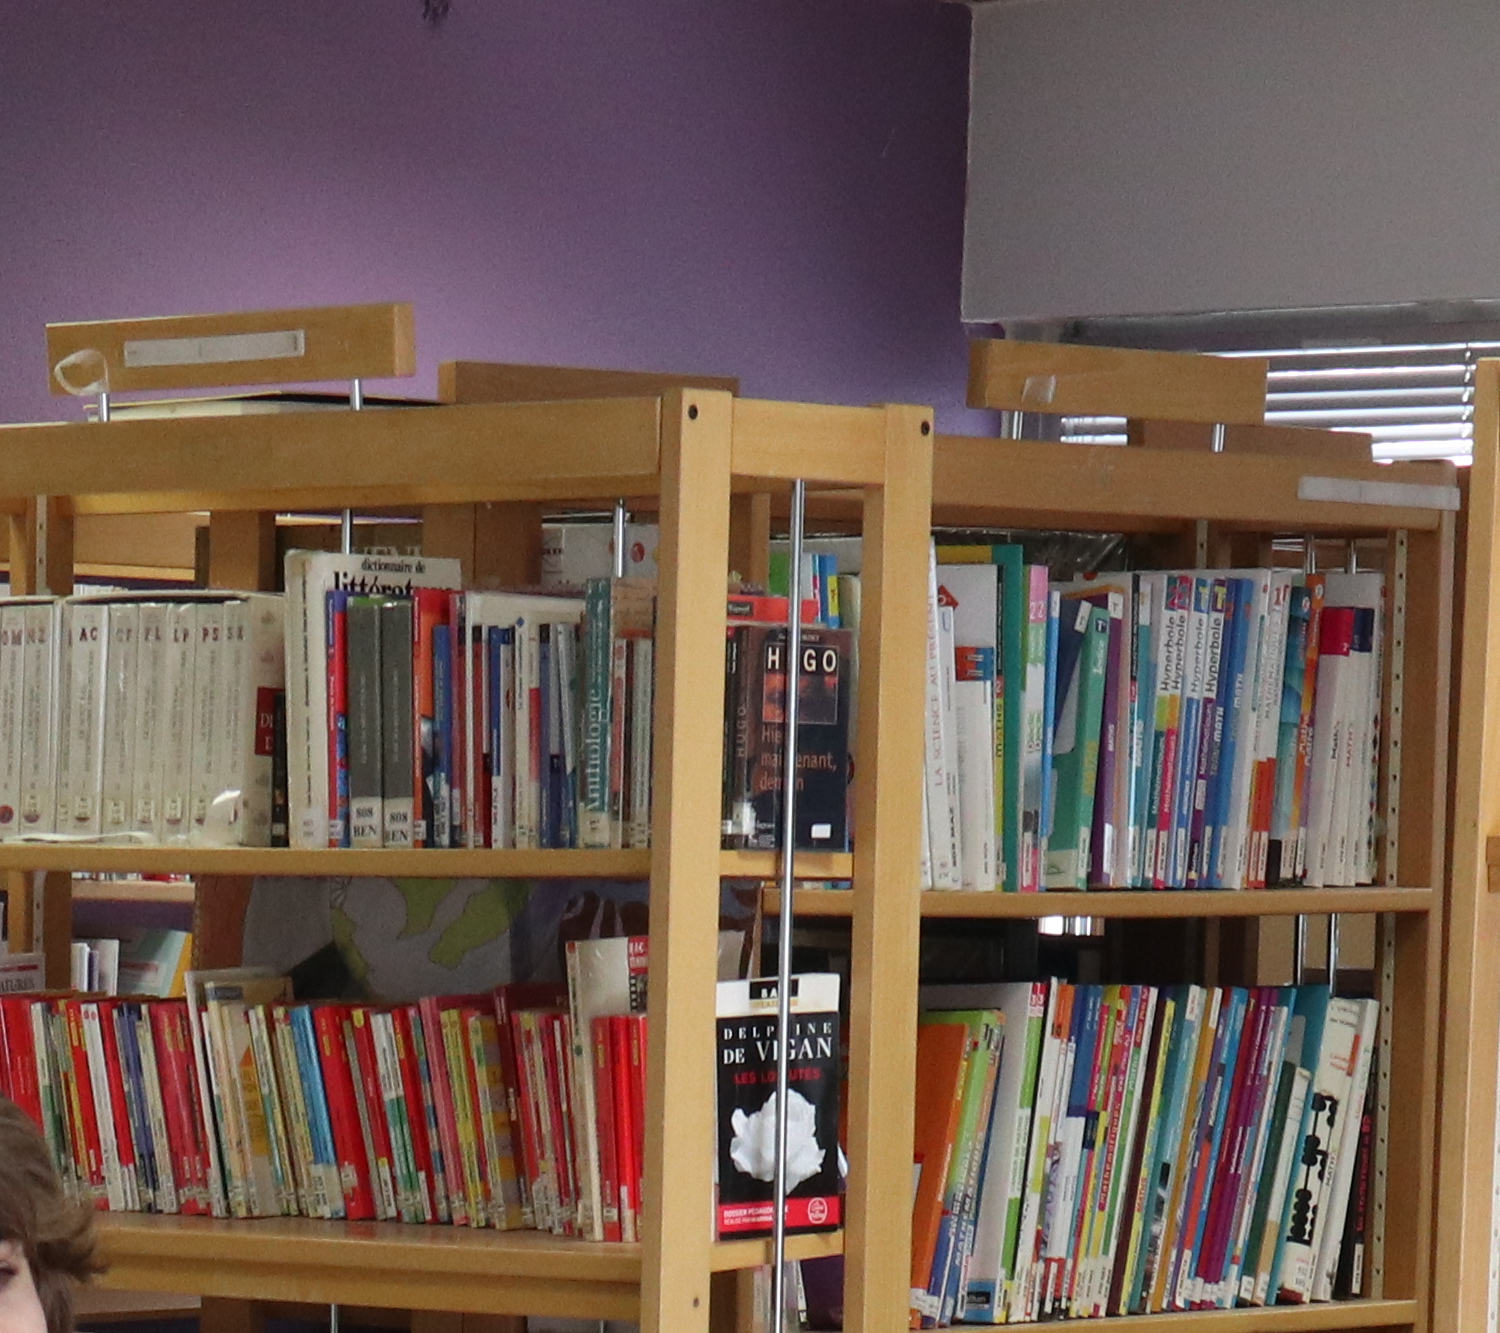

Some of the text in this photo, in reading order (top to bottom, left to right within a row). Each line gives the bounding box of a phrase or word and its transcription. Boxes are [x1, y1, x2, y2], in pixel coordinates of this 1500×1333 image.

[360, 557, 427, 574] dictionnaire de
[78, 626, 99, 643] AC
[201, 626, 220, 643] PS
[767, 646, 838, 673] HGO
[1189, 617, 1205, 694] Hyperbole
[1205, 617, 1222, 693] Hyperbole
[930, 692, 944, 765] SCIENCE
[352, 824, 379, 839] BEN
[723, 1021, 833, 1041] DELPINE
[723, 1047, 746, 1065] DE
